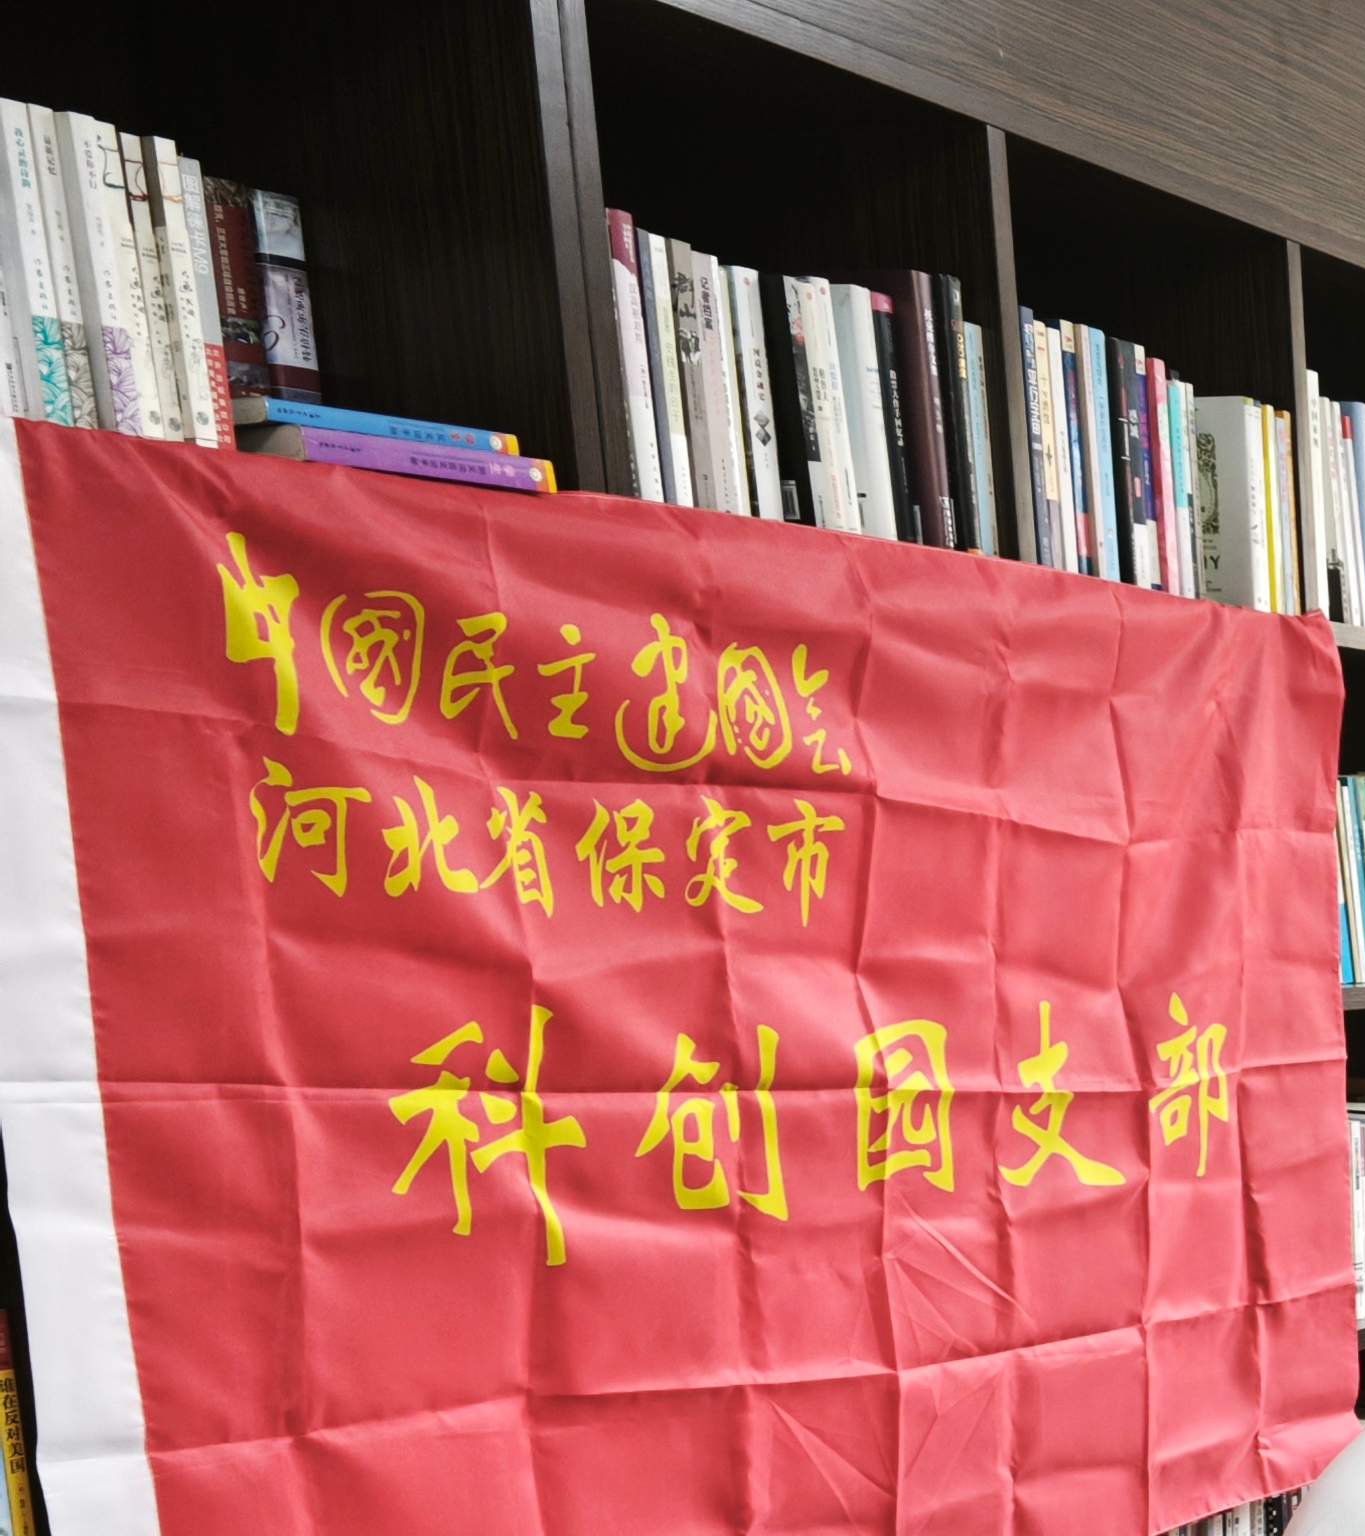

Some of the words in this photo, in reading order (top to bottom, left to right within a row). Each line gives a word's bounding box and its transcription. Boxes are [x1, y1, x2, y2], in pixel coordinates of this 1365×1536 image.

[249, 756, 846, 927] 河北省保定市
[389, 992, 1236, 1267] 科创园支部
